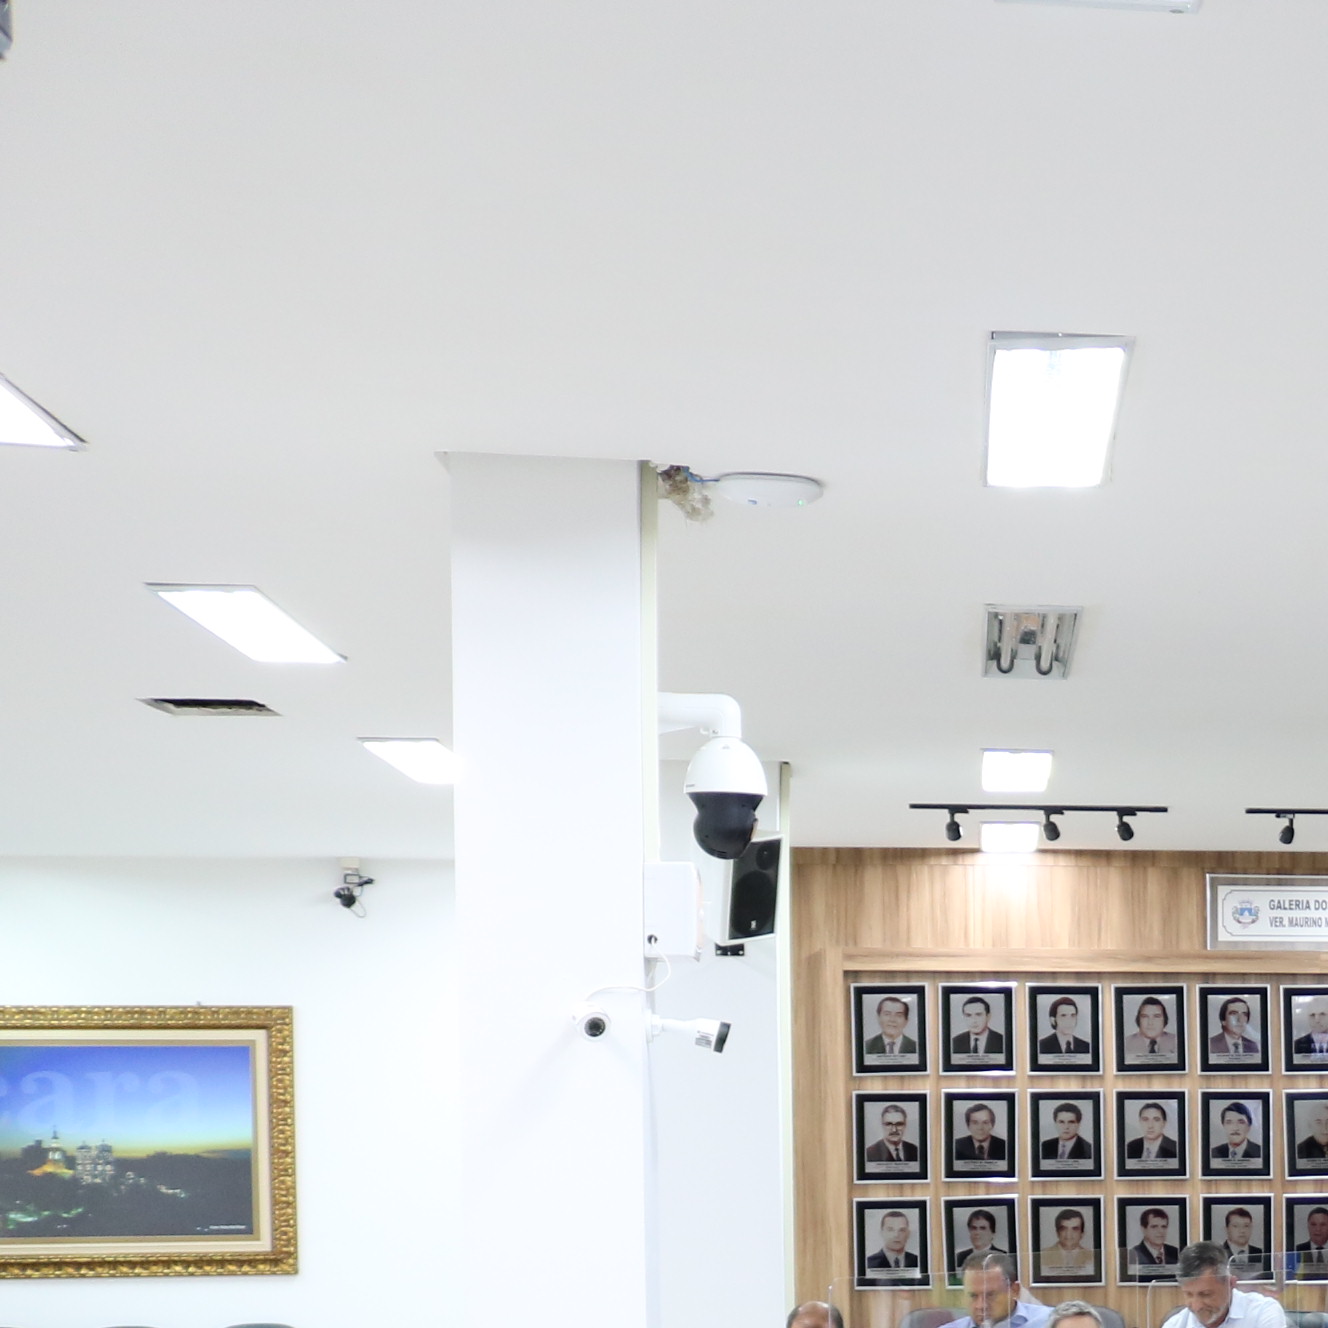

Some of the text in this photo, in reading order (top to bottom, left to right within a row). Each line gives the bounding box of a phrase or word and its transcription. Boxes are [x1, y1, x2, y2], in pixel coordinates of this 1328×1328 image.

[1268, 899, 1312, 912] GALERIA
[1269, 916, 1286, 928] VER.
[1288, 916, 1323, 929] MAURINO
[0, 1070, 202, 1133] ara
